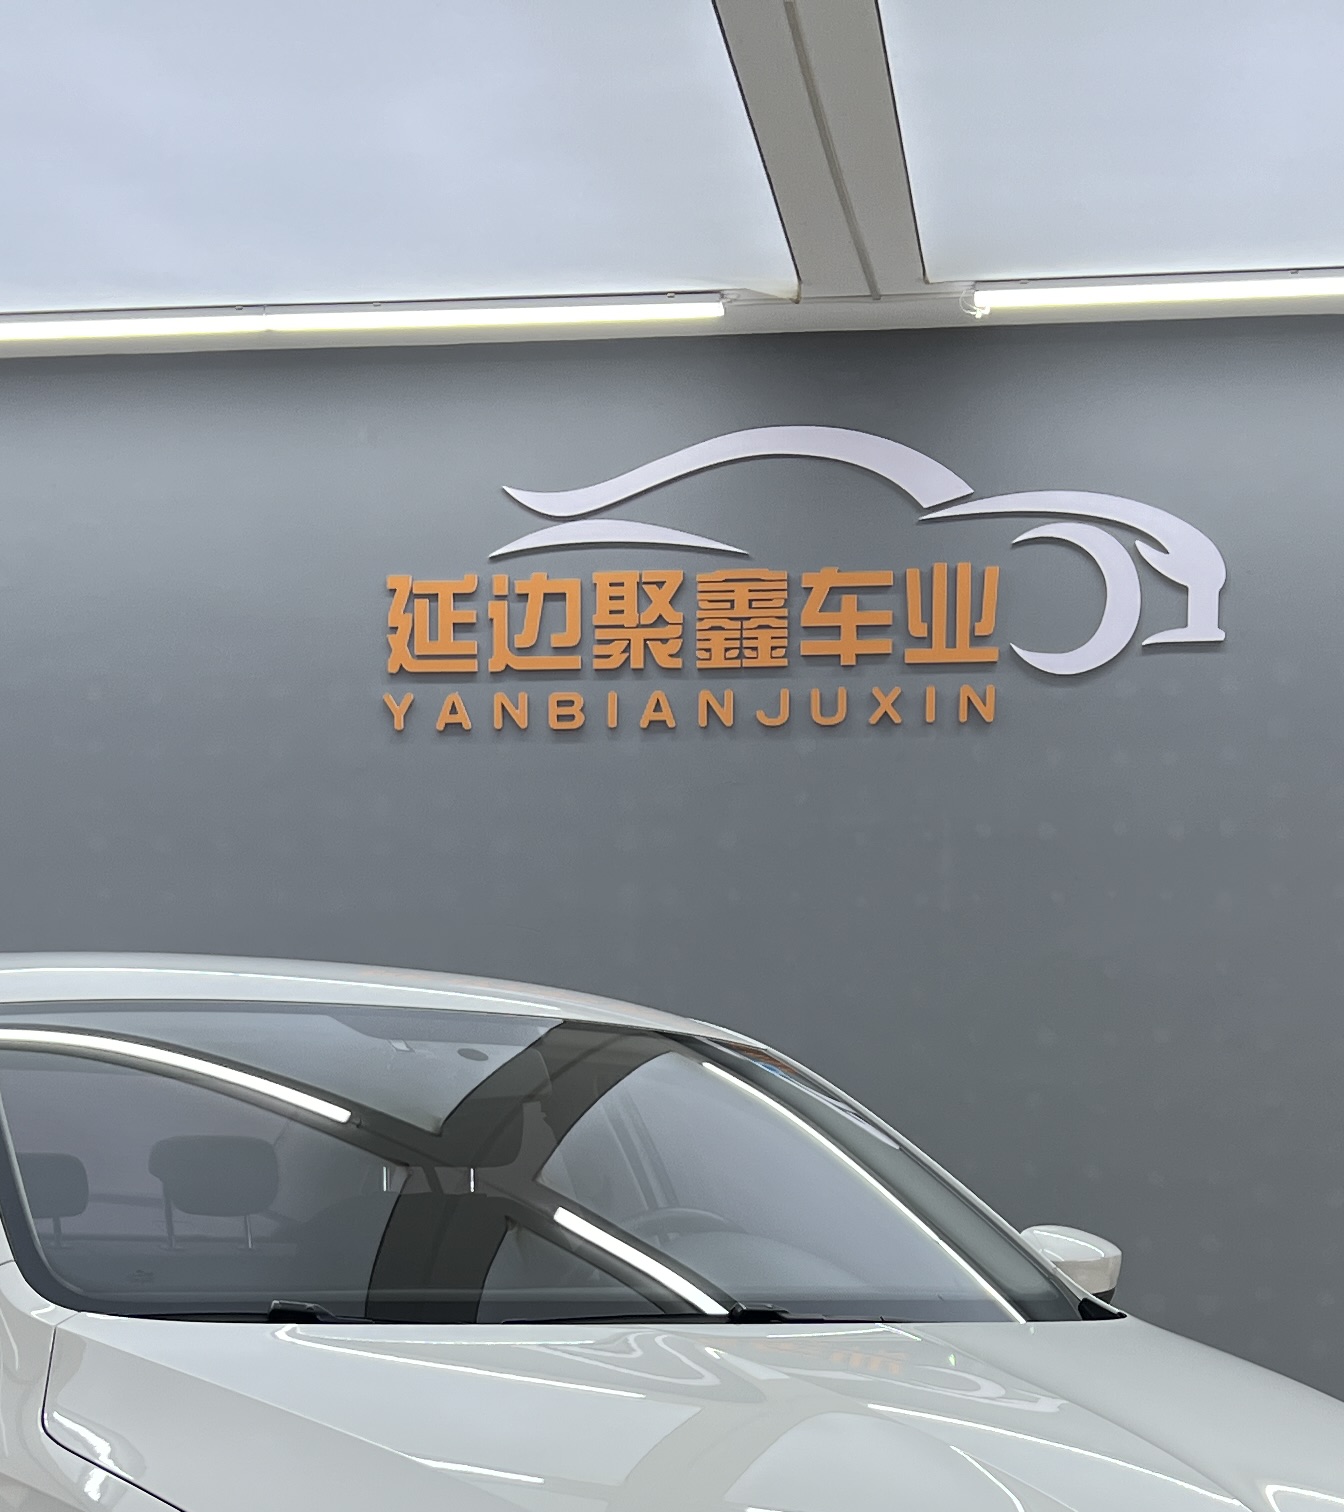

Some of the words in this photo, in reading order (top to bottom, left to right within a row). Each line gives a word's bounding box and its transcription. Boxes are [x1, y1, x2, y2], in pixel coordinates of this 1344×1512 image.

[386, 562, 1000, 675] 延边聚鑫车业
[382, 684, 998, 732] YANBIANJUXIN
